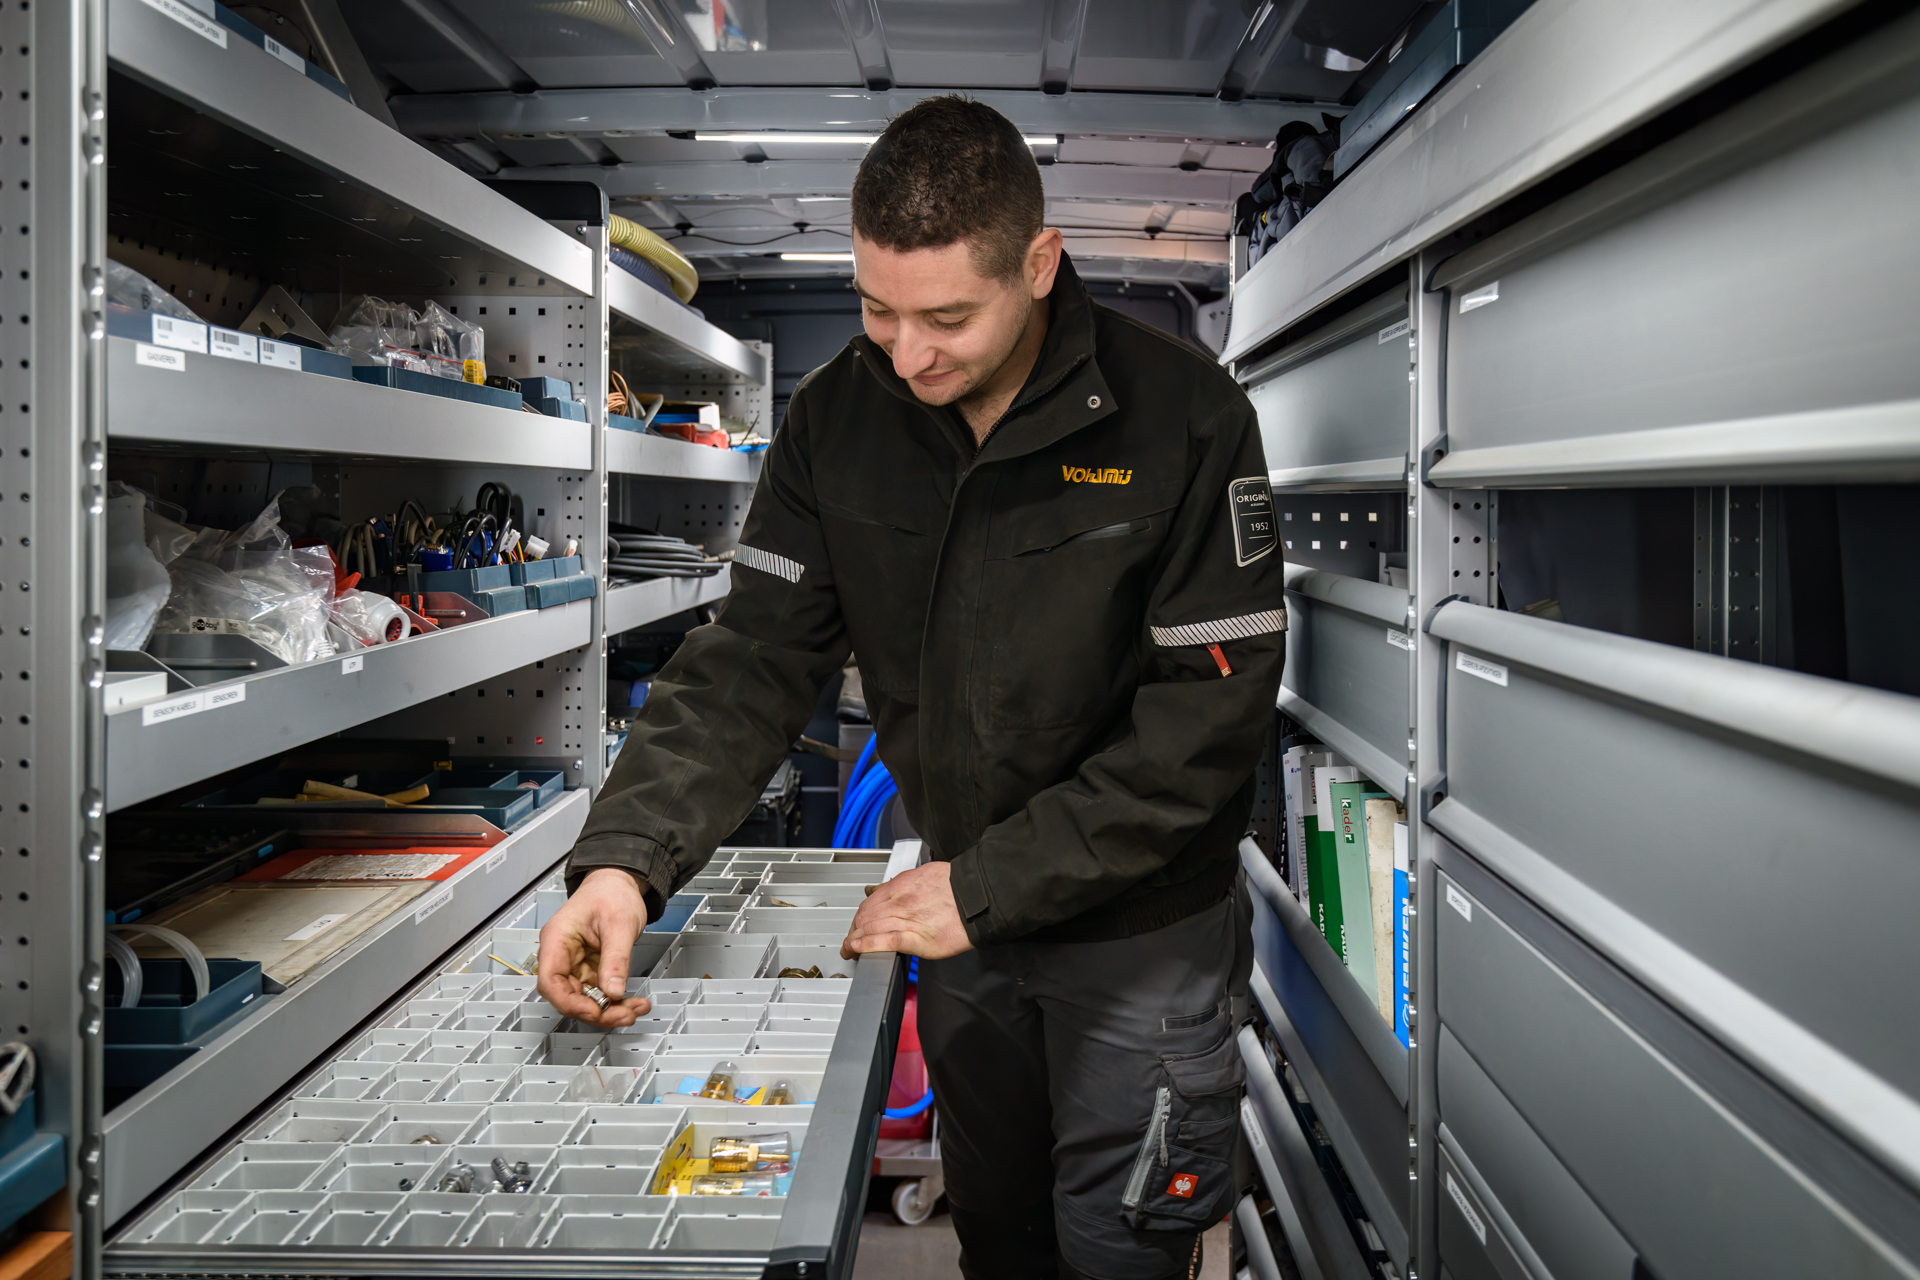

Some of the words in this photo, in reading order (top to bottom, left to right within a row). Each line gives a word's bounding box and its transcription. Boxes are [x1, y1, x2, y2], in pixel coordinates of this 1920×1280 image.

[1250, 521, 1269, 532] 1952
[1341, 797, 1355, 843] kader
[1340, 924, 1349, 968] KADE
